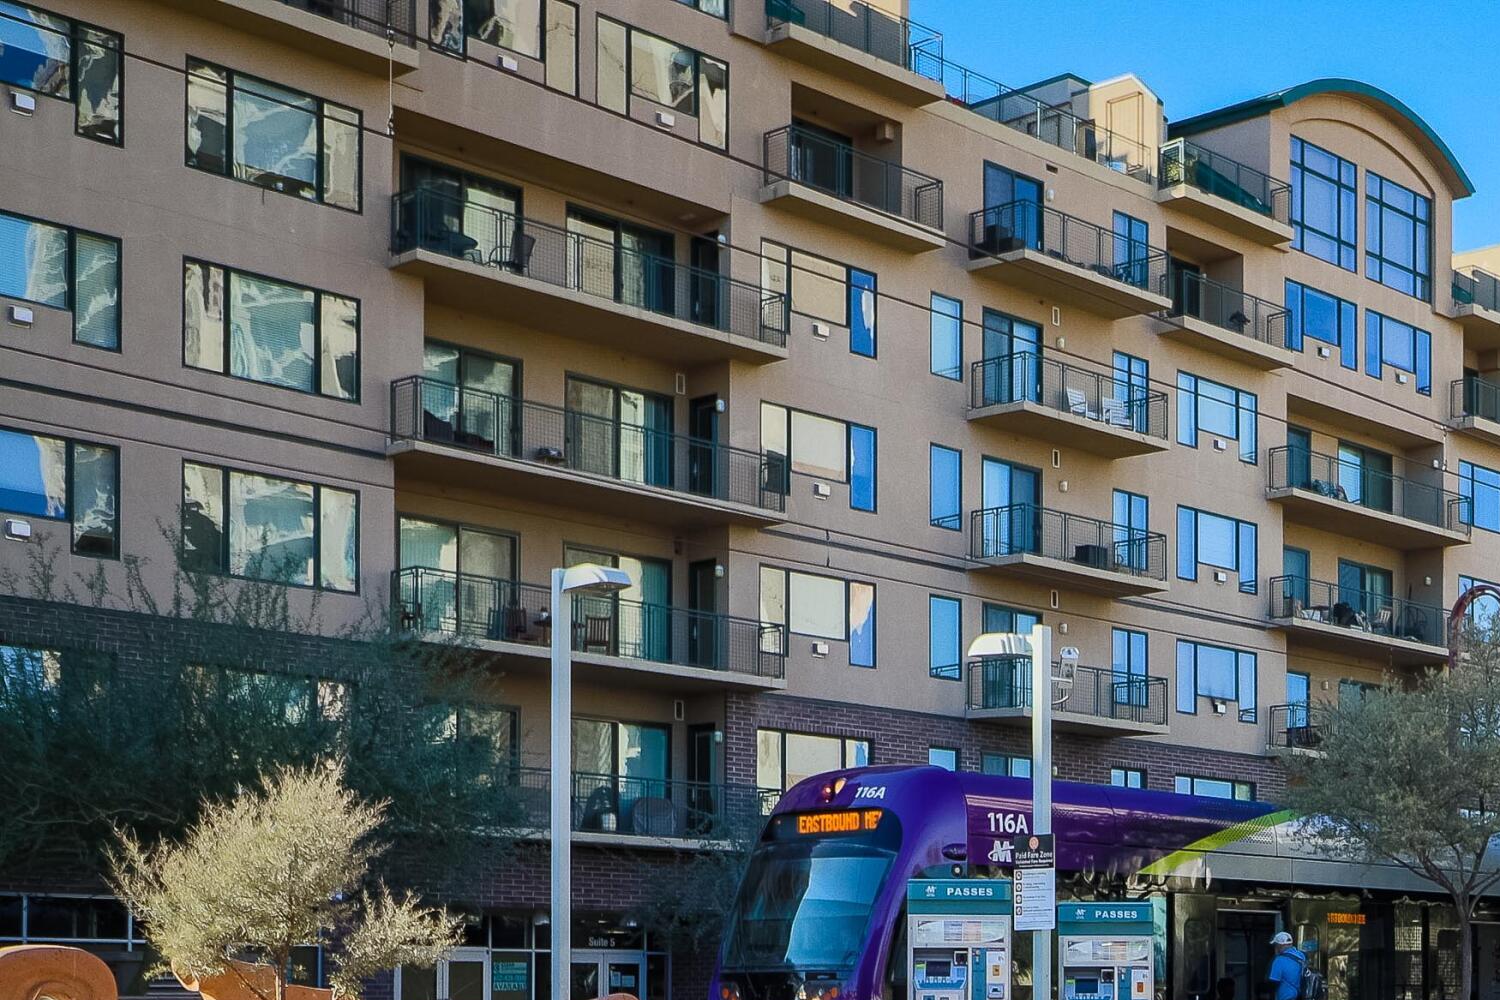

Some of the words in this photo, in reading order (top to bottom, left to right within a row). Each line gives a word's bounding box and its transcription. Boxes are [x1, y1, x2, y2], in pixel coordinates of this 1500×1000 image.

[855, 786, 886, 799] 116A
[798, 811, 860, 834] EASTBOUND
[987, 812, 1029, 834] 116A
[946, 887, 994, 896] PASSES
[1095, 910, 1138, 919] PASSES
[588, 936, 608, 947] Suite
[610, 937, 616, 947] 5
